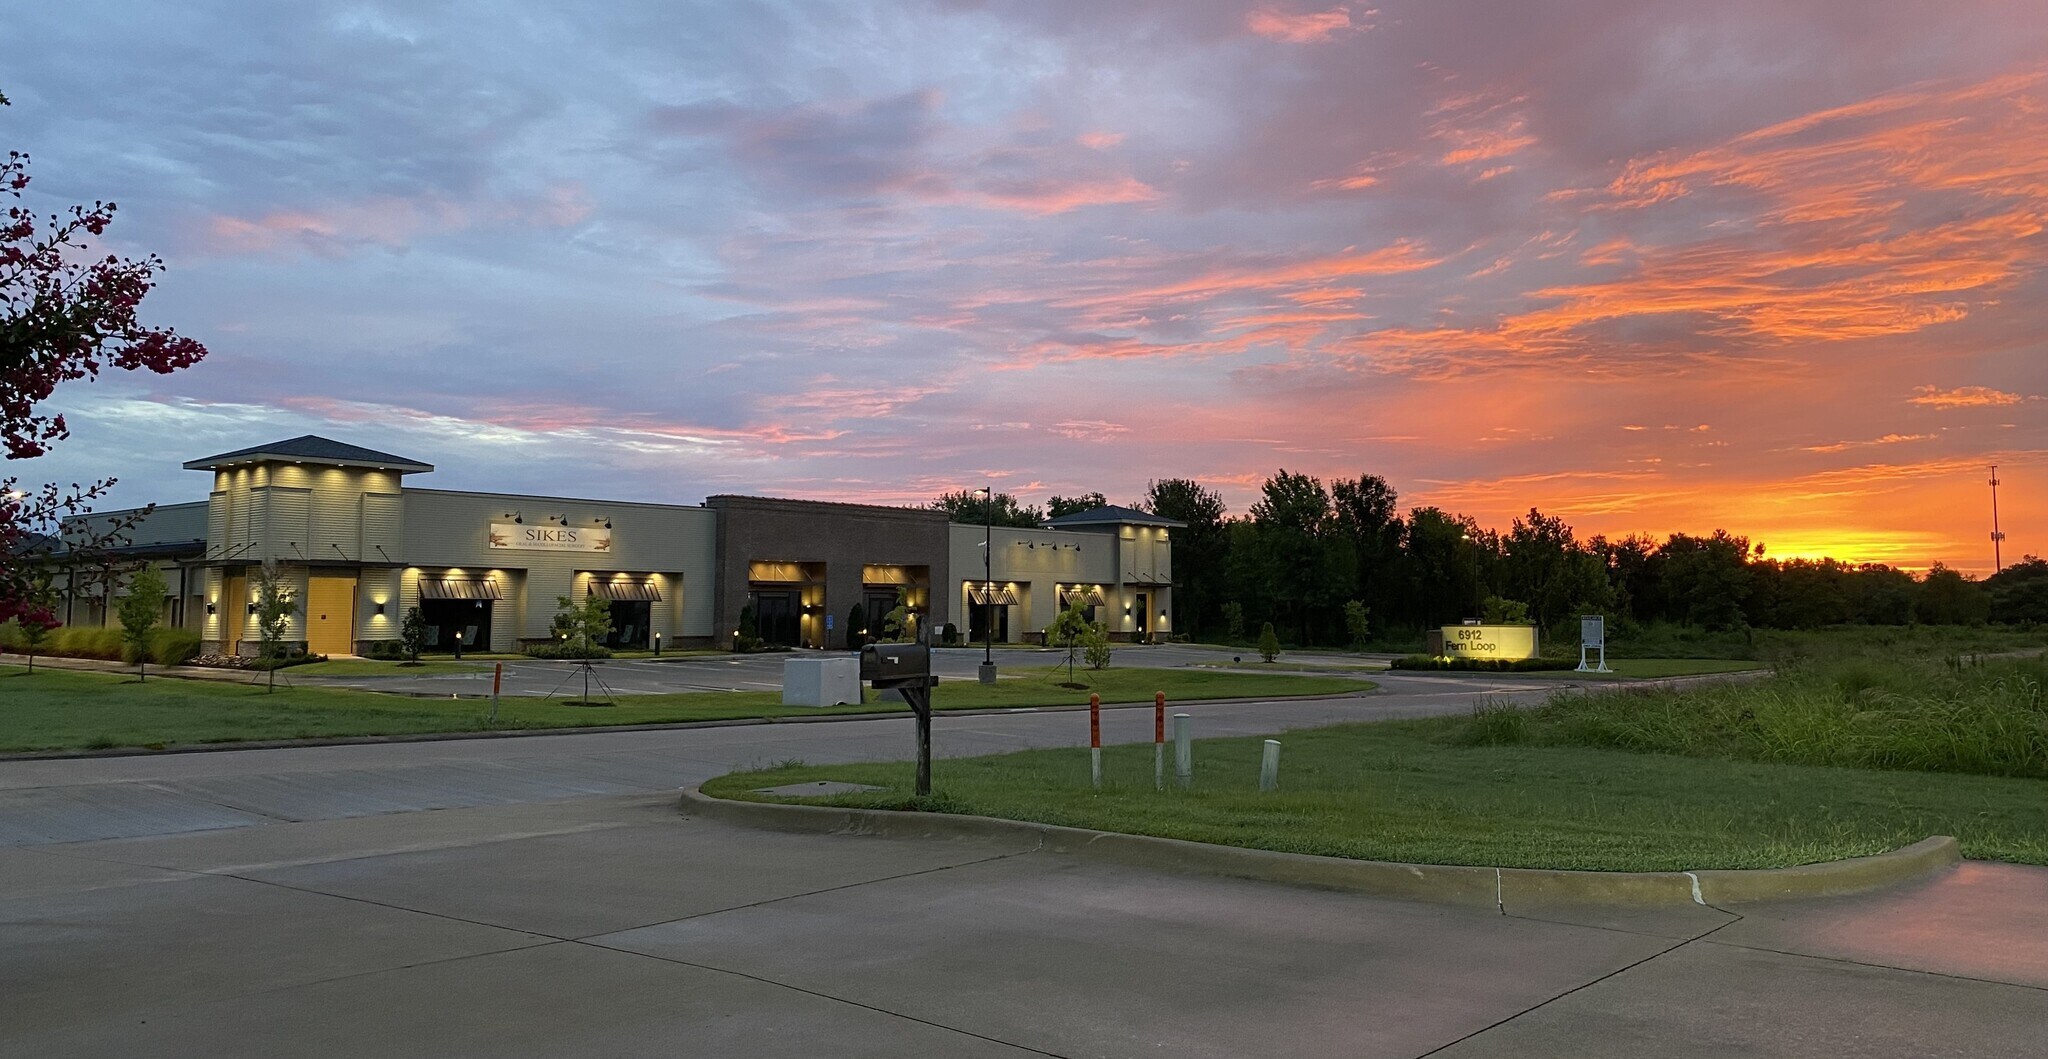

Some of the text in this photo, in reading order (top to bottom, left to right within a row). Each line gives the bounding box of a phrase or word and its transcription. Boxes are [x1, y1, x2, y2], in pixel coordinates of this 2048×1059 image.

[526, 529, 577, 542] SIKES
[1458, 630, 1482, 640] 6912
[1446, 641, 1496, 653] Fern Loop
